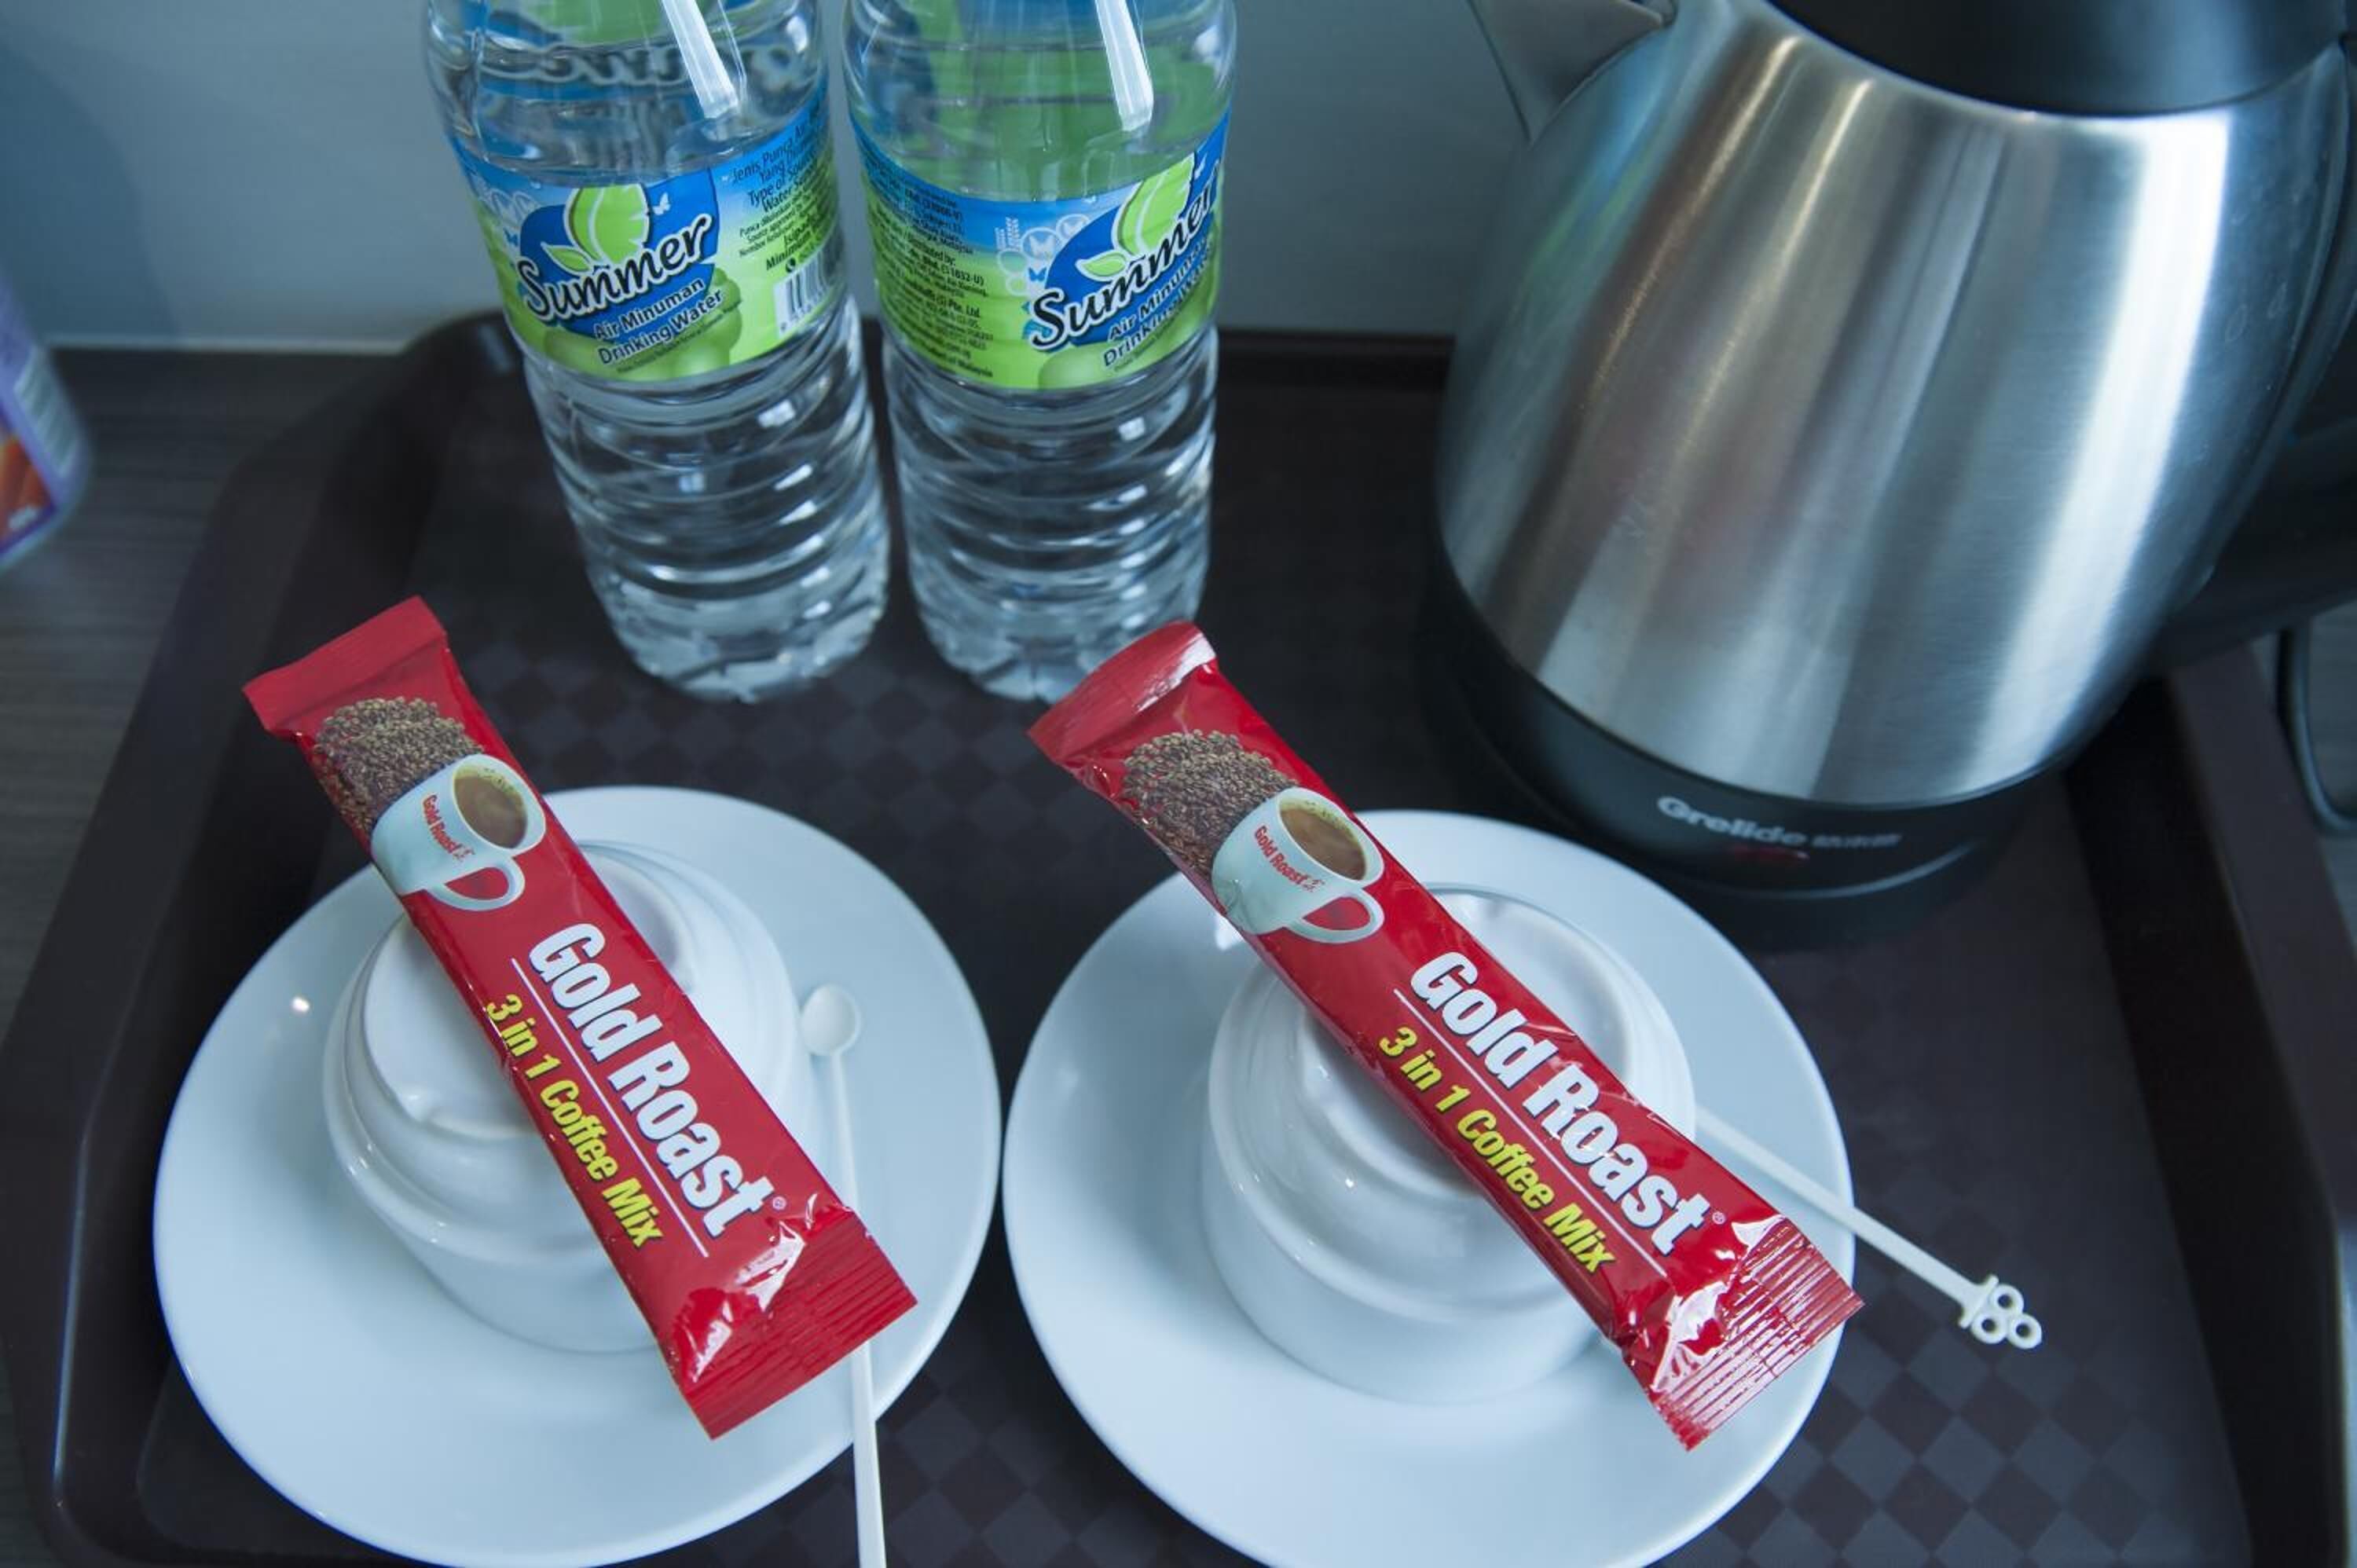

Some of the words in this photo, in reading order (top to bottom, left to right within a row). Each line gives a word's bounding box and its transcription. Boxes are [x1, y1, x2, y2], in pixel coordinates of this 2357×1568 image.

[747, 183, 775, 207] Type
[516, 216, 707, 317] Summer
[1032, 161, 1219, 347] Summer
[595, 323, 619, 340] Air
[620, 279, 705, 331] Minuman
[598, 325, 672, 365] Drinking
[671, 289, 722, 330] Water
[1109, 316, 1135, 340] Air
[1254, 826, 1278, 857] Gold
[1270, 853, 1308, 885] Roast
[486, 995, 522, 1021] 3
[501, 1017, 540, 1057] in
[526, 1053, 563, 1079] 1
[529, 923, 663, 1062] Gold
[608, 1041, 775, 1238] Roast
[540, 1079, 619, 1181] Coffee
[1410, 951, 1559, 1089] Gold
[1522, 1064, 1711, 1256] Roast
[1378, 1027, 1417, 1057] 3
[1400, 1050, 1444, 1093] in
[1435, 1084, 1472, 1113] 1
[1457, 1109, 1555, 1210] Coffee
[1544, 1203, 1616, 1273] Mix
[602, 1178, 663, 1247] Mix
